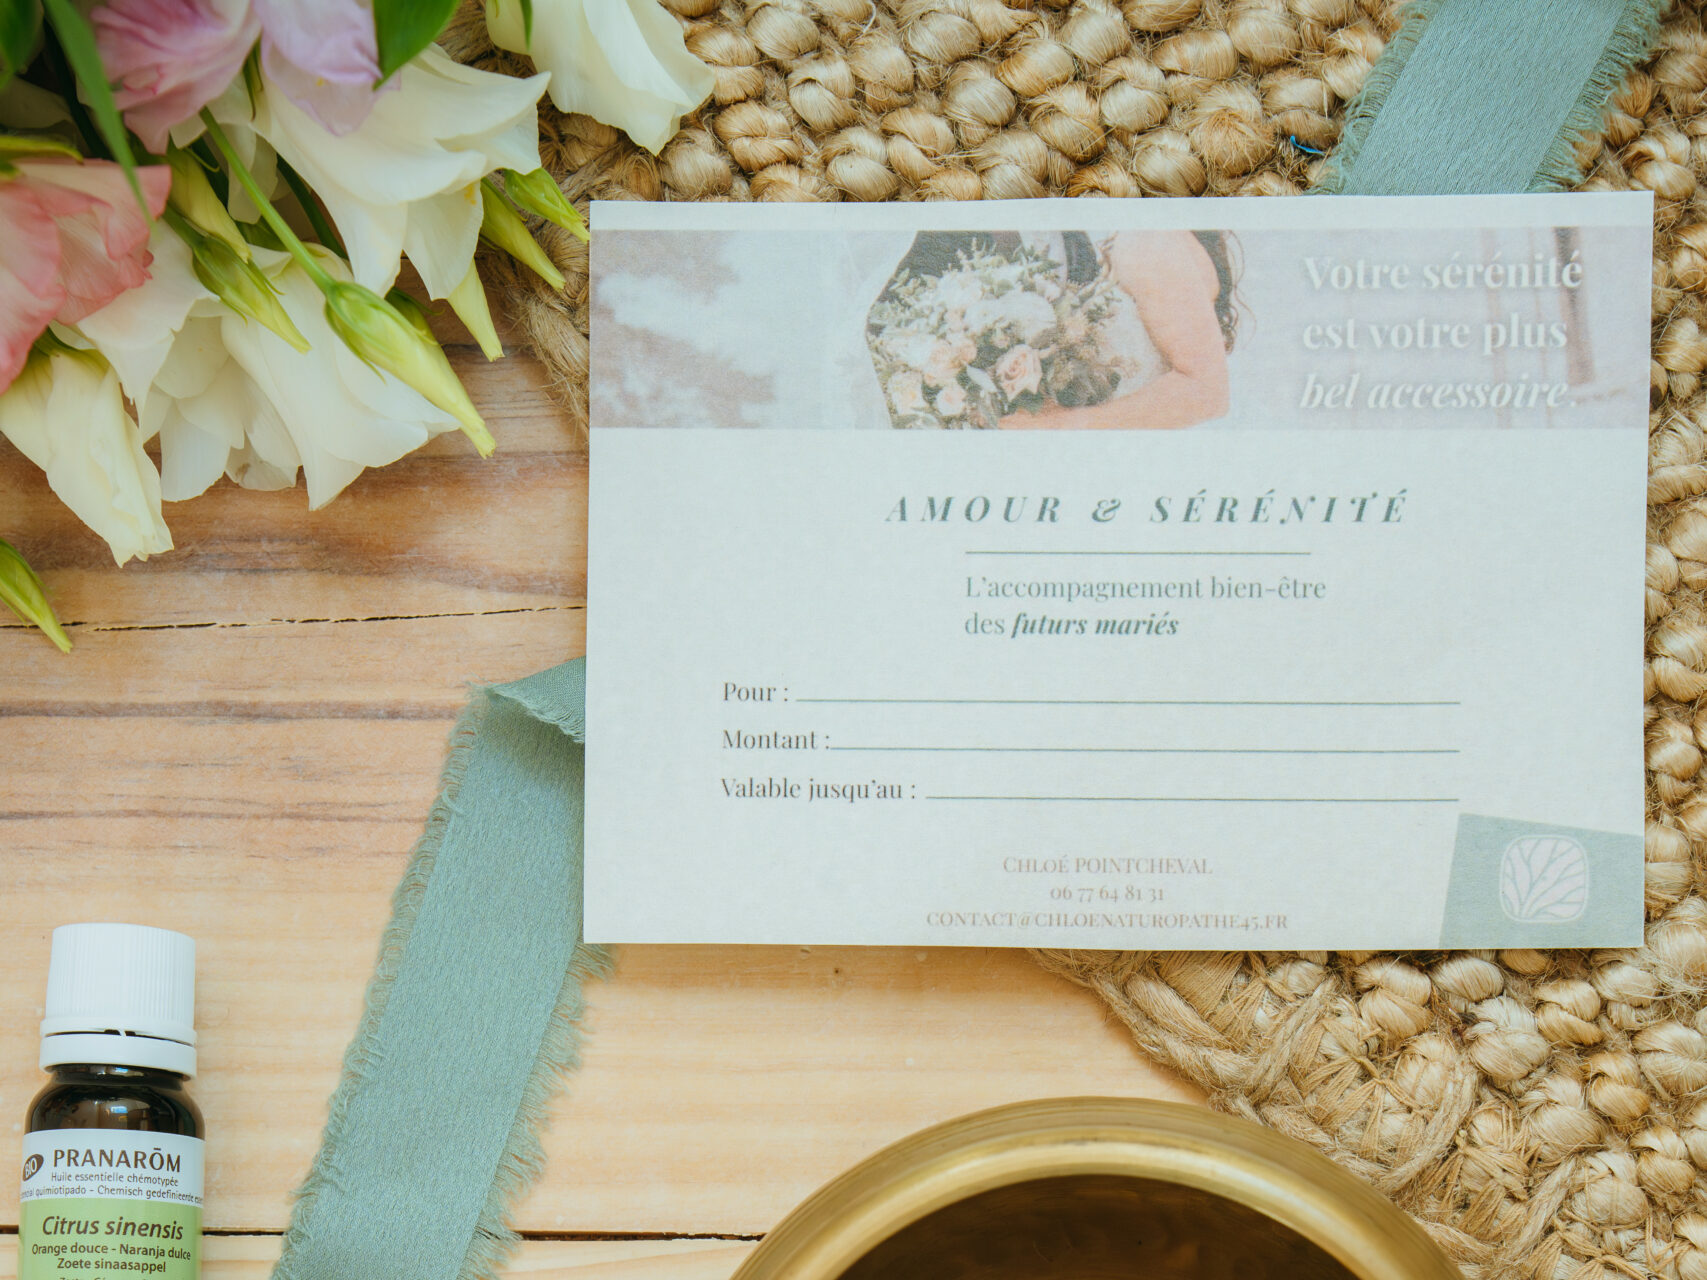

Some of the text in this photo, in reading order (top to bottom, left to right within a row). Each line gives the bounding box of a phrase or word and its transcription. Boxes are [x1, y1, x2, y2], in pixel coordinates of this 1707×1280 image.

[1304, 250, 1584, 290] Votre sérénité
[1302, 312, 1568, 356] est votre plus
[1300, 372, 1578, 409] bel accessoire.
[884, 488, 1409, 524] AMOUR & SÉRÉNITÉ
[1210, 575, 1327, 599] bien-être
[964, 612, 1180, 639] des futurs mariés
[722, 681, 777, 702] Pour
[722, 729, 817, 750] Montant
[721, 777, 801, 798] Valable
[1074, 857, 1213, 875] POINTCHEVAL
[1049, 885, 1165, 903] 06 77 64 81 31
[926, 910, 1289, 932] CONTACT@CHLOENATUROPATHE45.FR
[24, 1157, 38, 1179] BIO
[51, 1172, 179, 1188] Huile essentielle chémotypée
[97, 1184, 143, 1196] Chemisch
[42, 1215, 184, 1240] Citrus sinensis
[31, 1243, 68, 1257] Orange
[70, 1242, 109, 1254] douce
[119, 1243, 166, 1259] Naranja
[168, 1246, 191, 1261] dulce
[56, 1258, 167, 1275] Zoete sinaasappel
